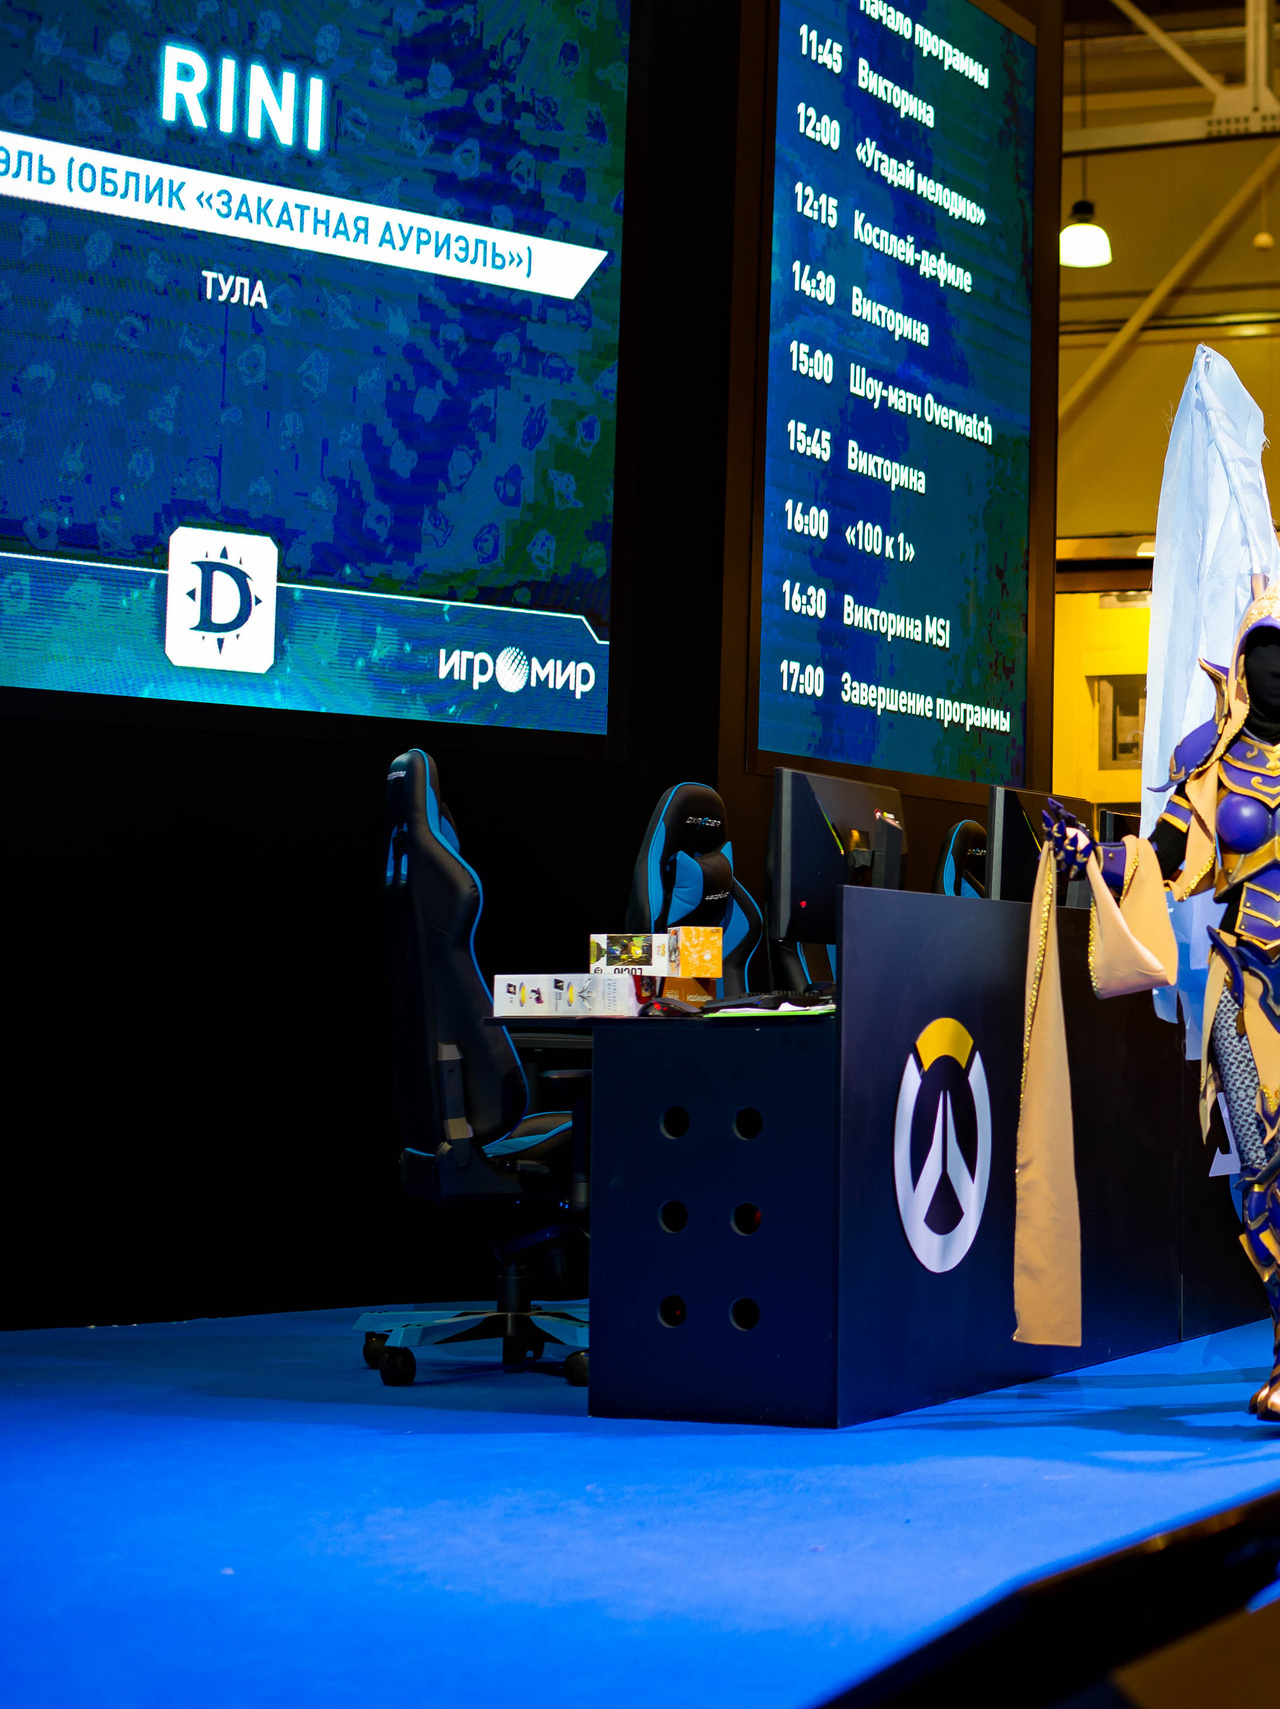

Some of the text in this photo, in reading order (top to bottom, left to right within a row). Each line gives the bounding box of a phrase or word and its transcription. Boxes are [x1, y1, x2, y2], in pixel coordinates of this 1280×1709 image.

[162, 45, 323, 151] RINI
[800, 24, 934, 128] 11:45 Викторина
[915, 24, 989, 89] программы
[797, 102, 986, 226] 12:00 «Угадай мелодию»
[67, 157, 186, 211] (ОБЛИК
[196, 189, 369, 245] «ЗАКАТНАЯ
[378, 221, 532, 278] АУРИЭЛЬ»)
[795, 181, 972, 293] 12:15 Косплей-дефиле
[201, 270, 268, 309] ТУЛА
[792, 260, 929, 347] 14:30 Викторина
[790, 340, 992, 445] 15:00 Шоу-матч Overwatch
[787, 419, 926, 494] 15:45 Викторина
[785, 499, 915, 562] 16:00 «100 к 1»
[782, 579, 950, 649] 16:30 Викторина MSI
[780, 659, 1010, 733] 17:00 Завершение программы
